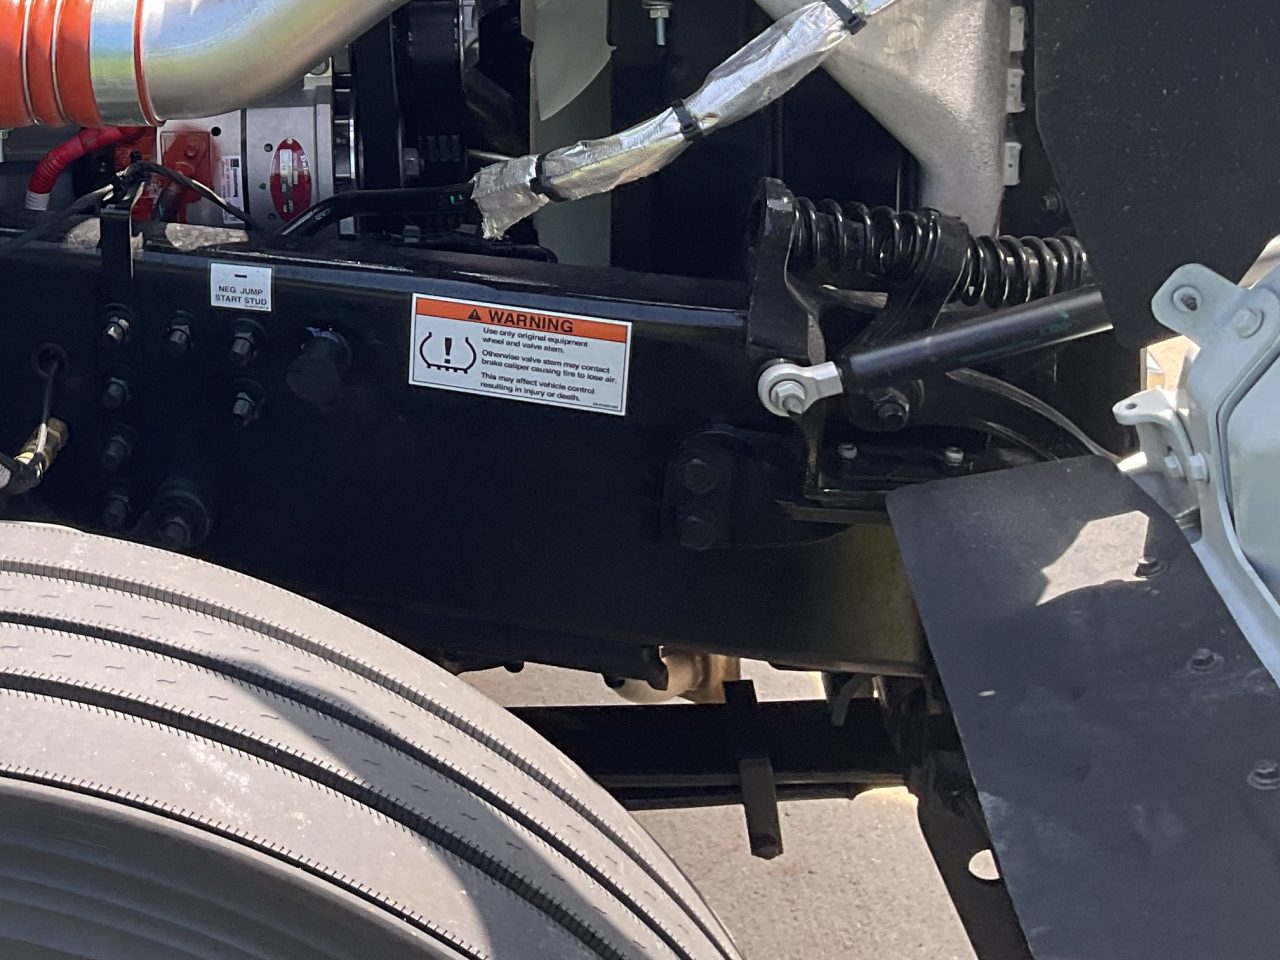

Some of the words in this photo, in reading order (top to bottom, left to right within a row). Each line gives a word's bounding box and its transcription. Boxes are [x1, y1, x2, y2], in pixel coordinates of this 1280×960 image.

[214, 294, 242, 303] START
[244, 297, 267, 306] STUD
[218, 285, 236, 294] NEG
[240, 288, 263, 296] JUMP
[488, 310, 574, 333] WARNING
[482, 327, 498, 335] Use
[500, 330, 516, 338] only
[517, 332, 546, 342] original
[548, 336, 588, 348] equipment
[482, 336, 504, 345] wheel
[522, 342, 542, 350] valve
[544, 344, 565, 354] stem.
[481, 358, 502, 367] brake
[504, 361, 530, 372] caliper
[530, 365, 562, 376] causing
[562, 369, 576, 378] tire
[586, 372, 604, 382] lose
[605, 375, 618, 384] air.
[482, 349, 520, 360] Otherwise
[522, 355, 542, 364] valve
[543, 358, 562, 366] stem
[563, 362, 580, 371] may
[581, 364, 610, 374] contact
[480, 372, 496, 380] This
[498, 374, 514, 385] may
[515, 376, 538, 388] affect
[538, 380, 566, 391] vehicle
[567, 384, 595, 395] control
[480, 382, 513, 393] resulting
[514, 386, 522, 394] in
[524, 388, 545, 398] injury
[546, 391, 556, 399] or
[556, 391, 580, 402] death.
